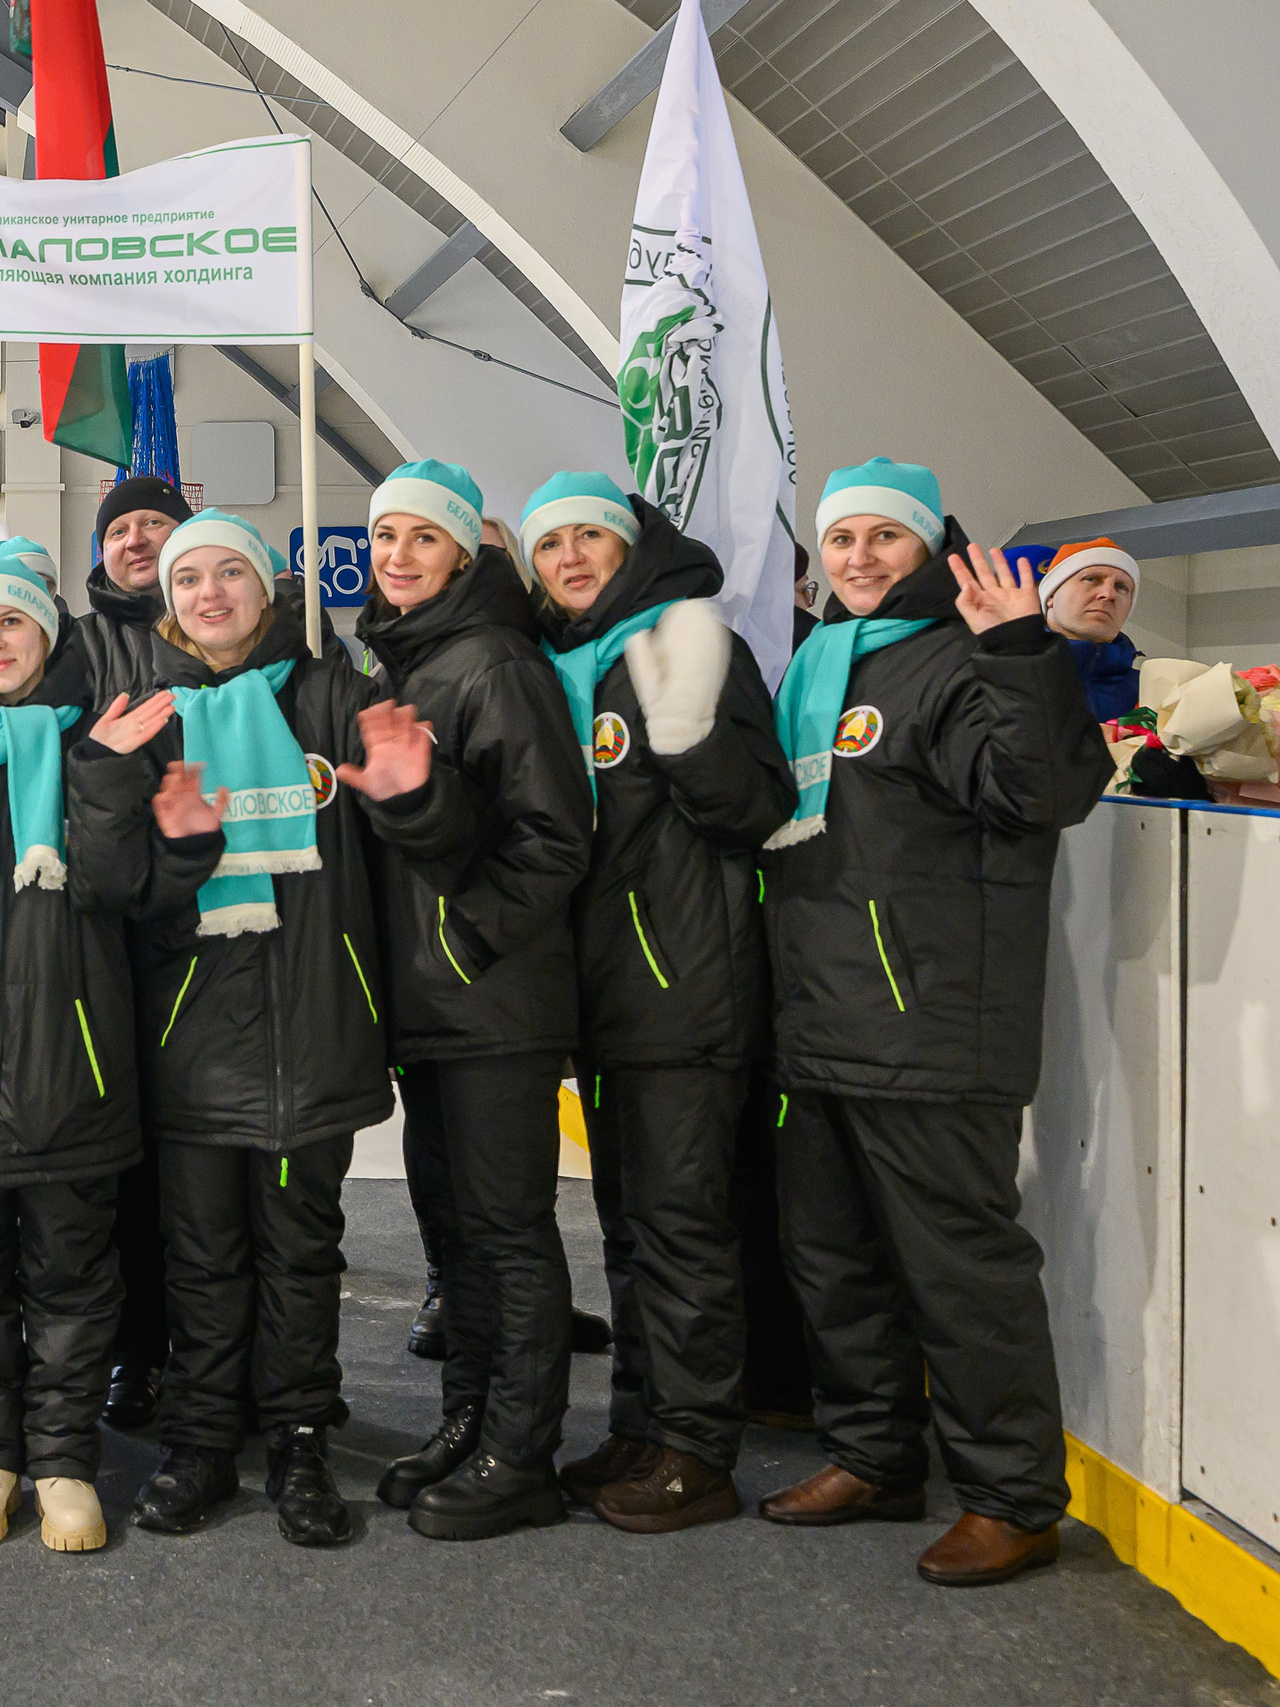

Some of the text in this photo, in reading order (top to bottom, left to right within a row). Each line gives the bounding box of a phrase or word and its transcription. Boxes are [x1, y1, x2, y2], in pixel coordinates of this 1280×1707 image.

[62, 213, 128, 228] унитарное
[132, 210, 215, 225] предприятие
[70, 270, 157, 286] компания
[164, 266, 253, 284] холдинга
